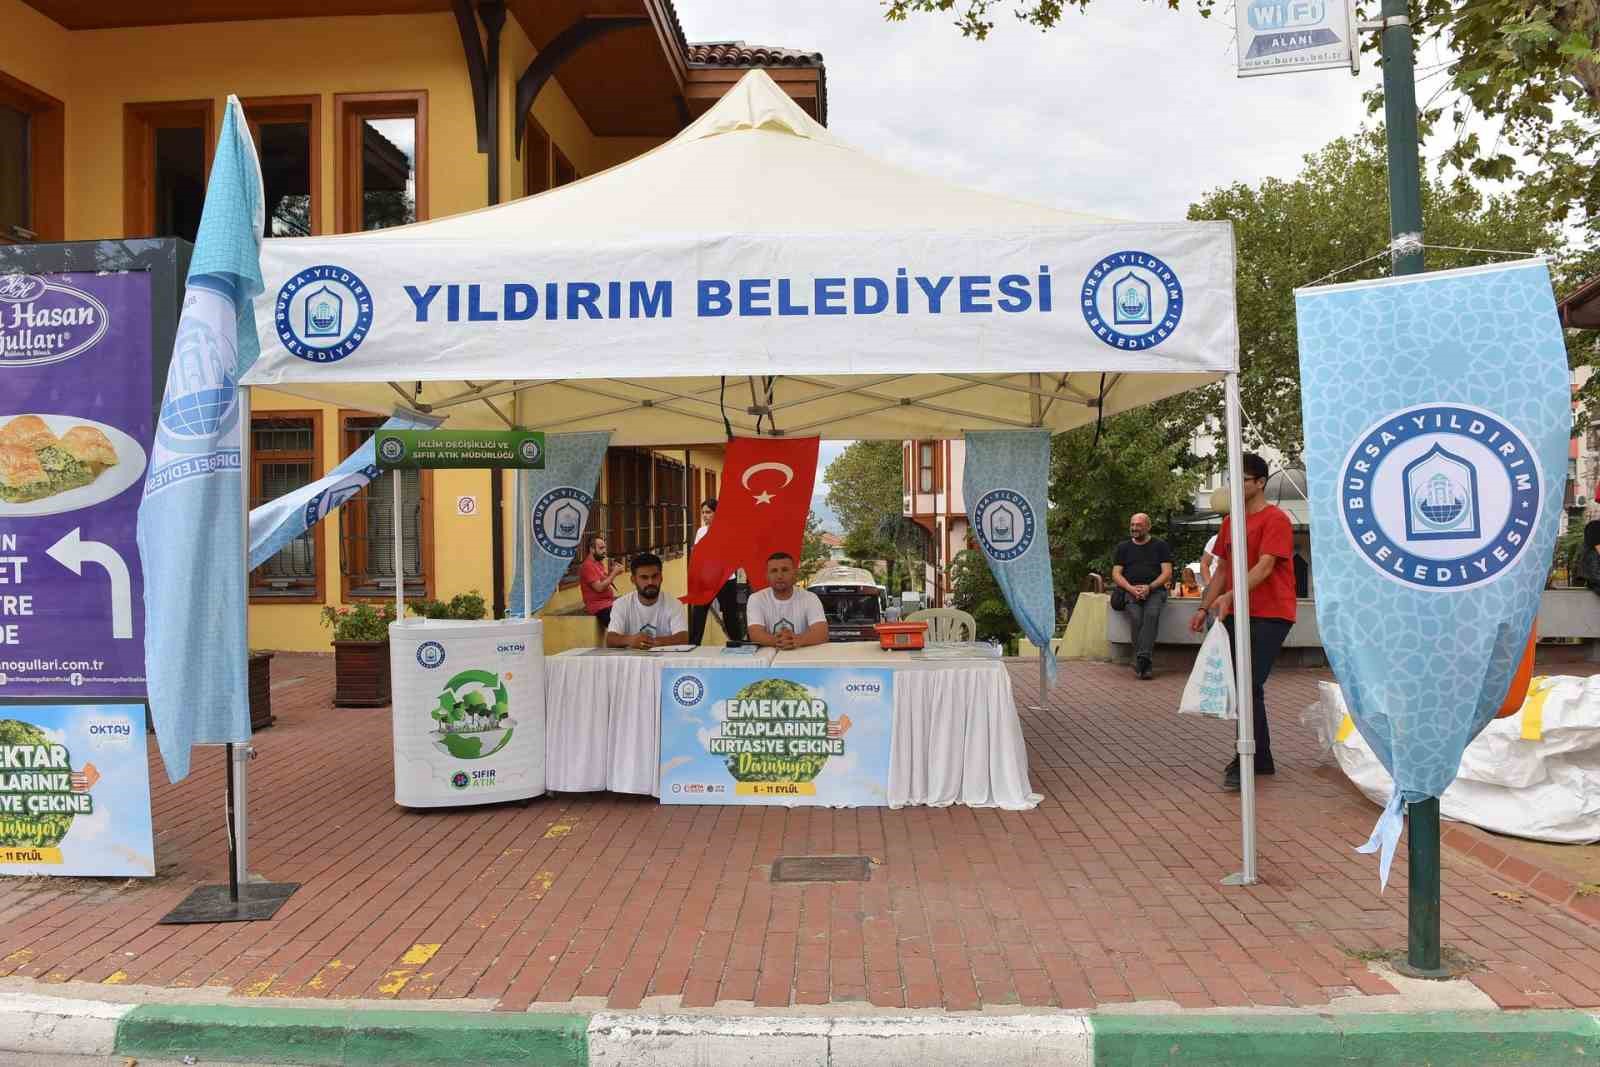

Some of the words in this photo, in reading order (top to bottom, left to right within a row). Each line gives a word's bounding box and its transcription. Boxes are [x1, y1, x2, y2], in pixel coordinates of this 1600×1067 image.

[1271, 35, 1313, 48] ALANI
[1084, 263, 1111, 306] BURSA
[1119, 255, 1179, 300] YILDIRIM
[277, 276, 305, 320] BURSA
[313, 268, 369, 312] YILDIRIM
[403, 281, 673, 322] YILDIRIM
[697, 265, 1052, 318] BELEDİYESİ
[8, 302, 95, 329] Hasan
[498, 441, 510, 449] VE
[437, 451, 459, 459] ATIK
[1349, 430, 1397, 510] BURSA
[1411, 414, 1532, 491] YILDIRIM
[1360, 517, 1529, 582] BELEDİYESİ
[496, 643, 525, 652] OKTAY
[0, 658, 104, 673] nogullari.com.tr
[846, 683, 880, 693] OKTAY
[727, 699, 825, 718] EMEKTAR
[90, 724, 131, 736] OKTAY
[471, 769, 497, 779] SIFIR
[767, 785, 773, 793] 11
[775, 783, 799, 794] EYLÜL
[6, 852, 13, 861] 11
[15, 849, 43, 861] EYLÜL
